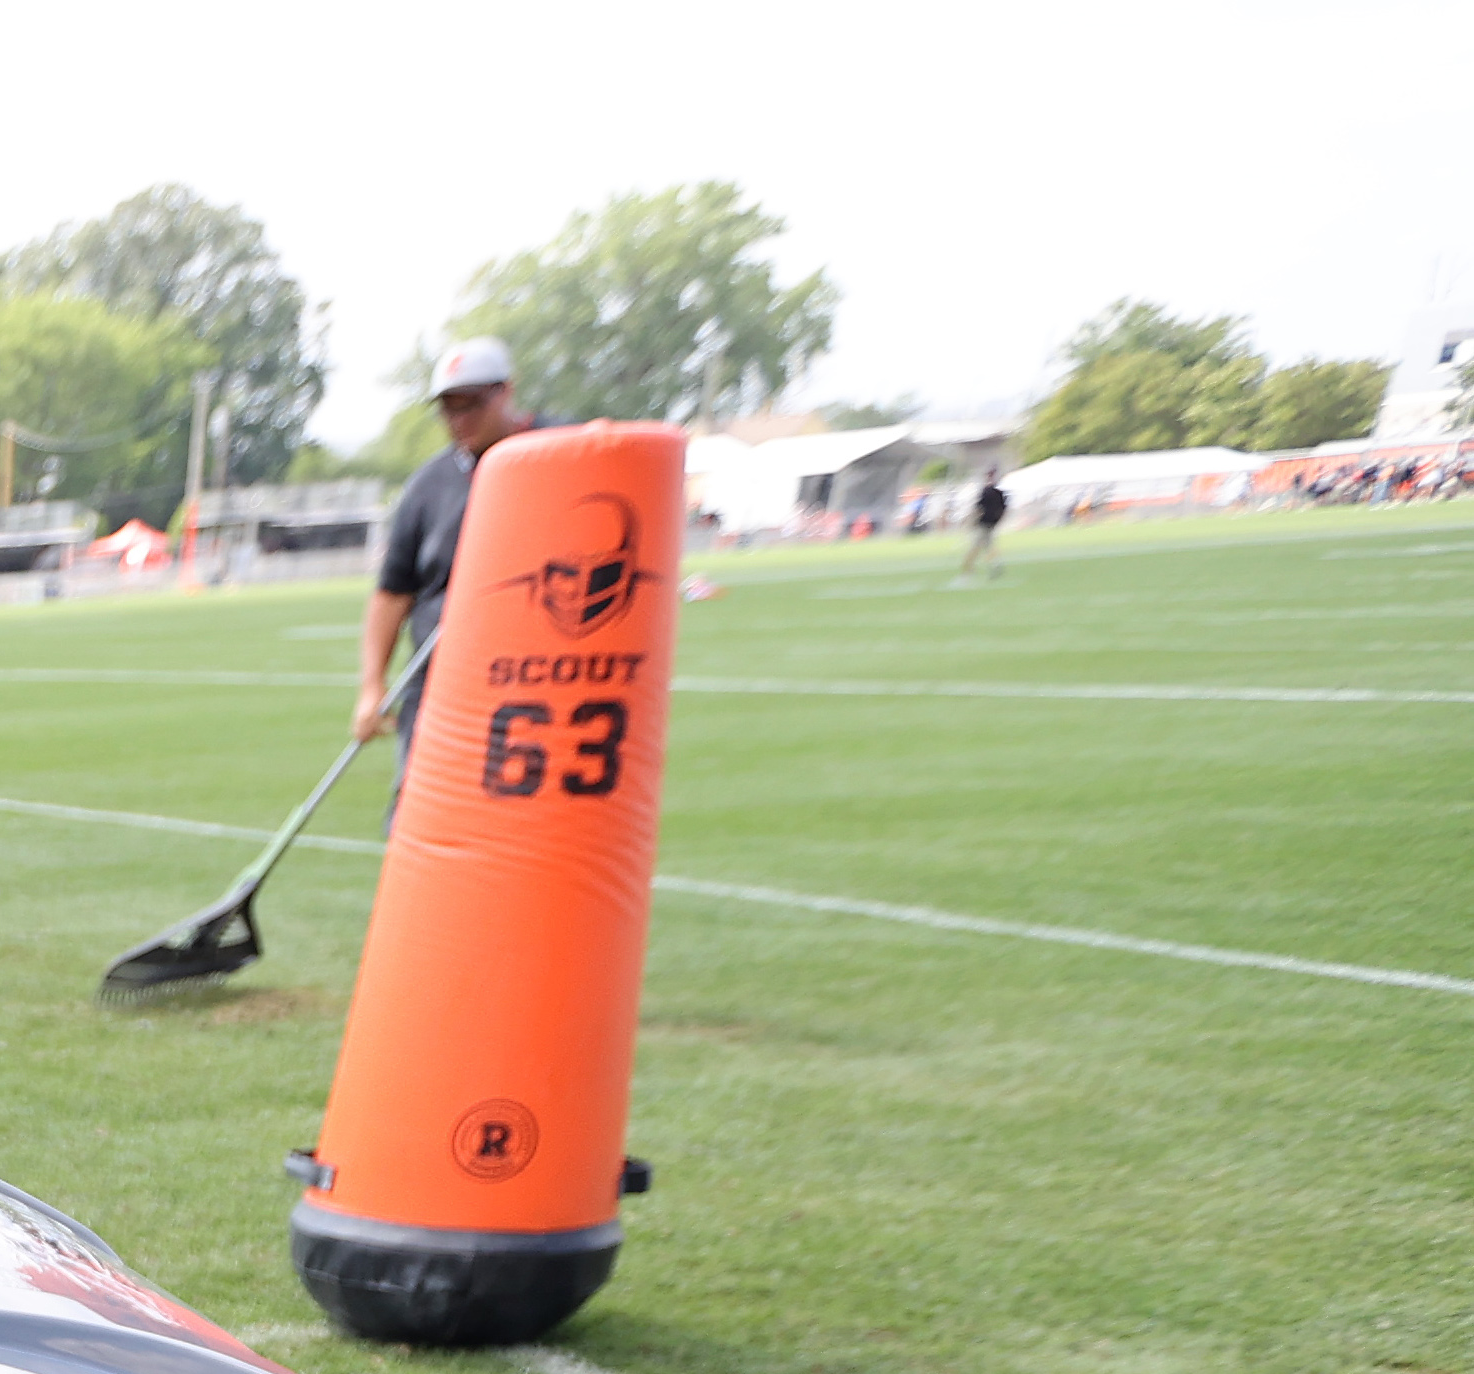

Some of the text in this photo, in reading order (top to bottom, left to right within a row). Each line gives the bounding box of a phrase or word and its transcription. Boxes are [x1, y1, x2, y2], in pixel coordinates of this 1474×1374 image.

[487, 650, 649, 688] SCOUT
[480, 699, 629, 798] 63
[478, 1121, 511, 1156] R
